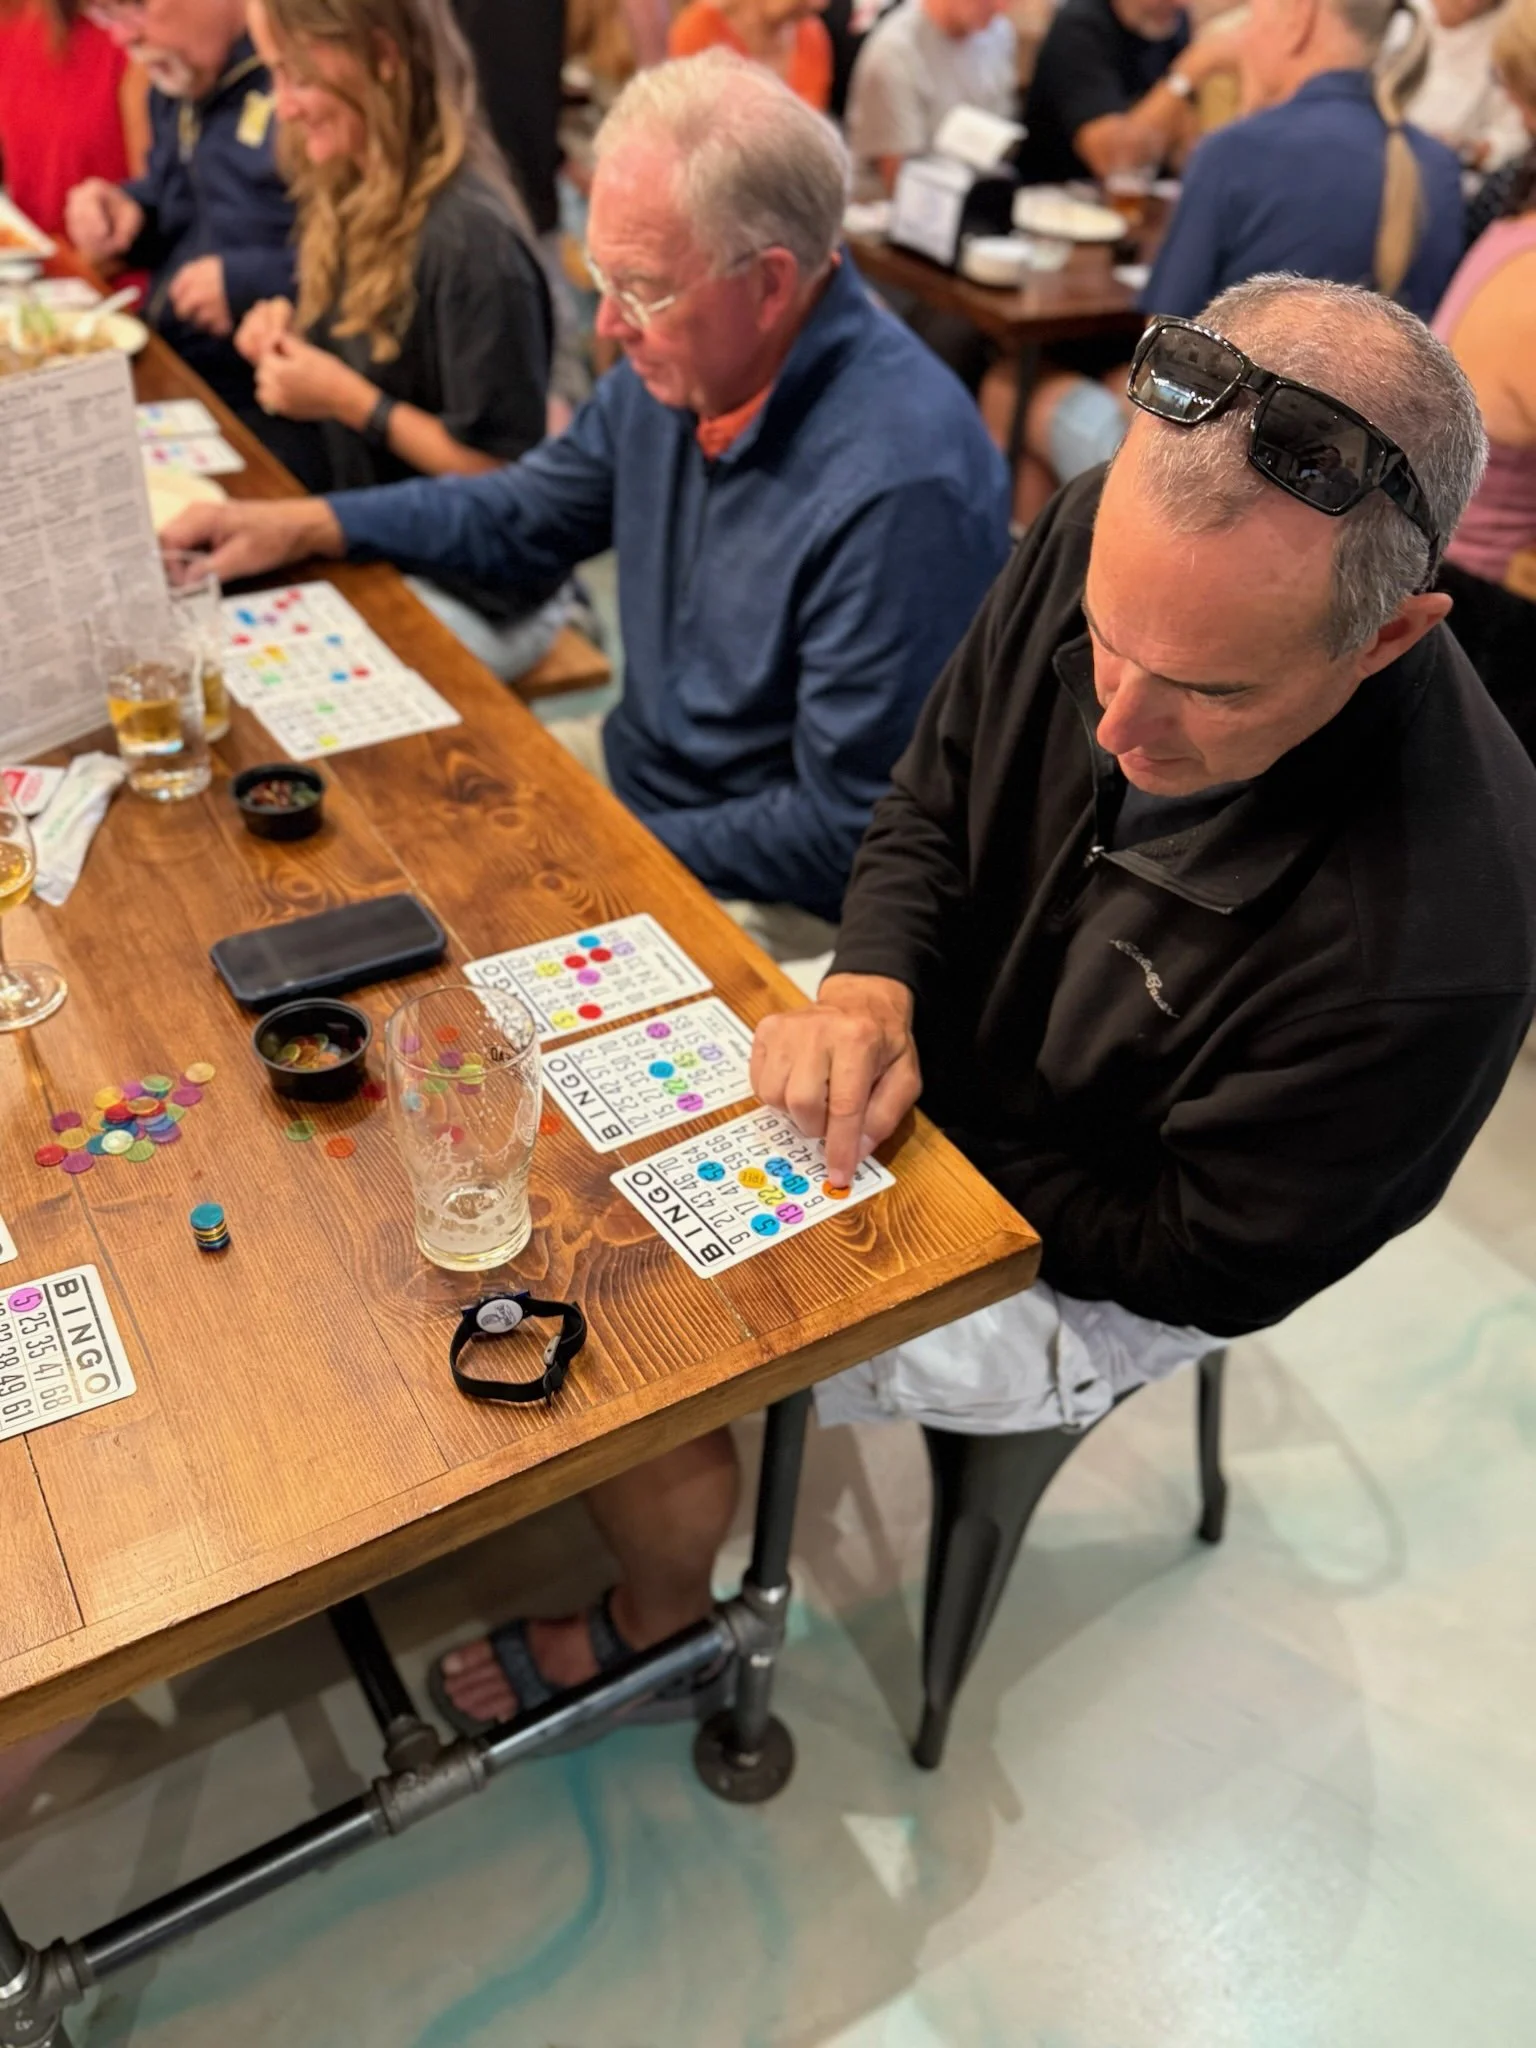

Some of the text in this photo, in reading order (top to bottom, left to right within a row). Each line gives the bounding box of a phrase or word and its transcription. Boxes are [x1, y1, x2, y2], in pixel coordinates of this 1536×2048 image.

[585, 1065, 611, 1080] 57
[599, 1080, 623, 1094] 42
[638, 1088, 664, 1103] 27
[704, 1087, 724, 1099] 3
[548, 1058, 622, 1141] BINGO
[612, 1095, 639, 1112] 25
[627, 1113, 652, 1128] 12
[752, 1115, 779, 1131] 67
[705, 1135, 733, 1153] 66
[770, 1129, 794, 1146] 49
[722, 1151, 749, 1171] 59
[788, 1145, 812, 1163] 42
[731, 1125, 824, 1208] 6 19 32 47 74
[682, 1146, 776, 1232] 5 17 41 54 64
[758, 1185, 785, 1205] 22
[657, 1156, 750, 1244] 9 21 43 46 70
[632, 1170, 725, 1262] BINGO
[777, 1204, 803, 1222] 13
[54, 1278, 111, 1394] BINGO
[14, 1293, 73, 1410] 5 25 35 47 68
[0, 1374, 27, 1397] 49
[2, 1399, 34, 1422] 61
